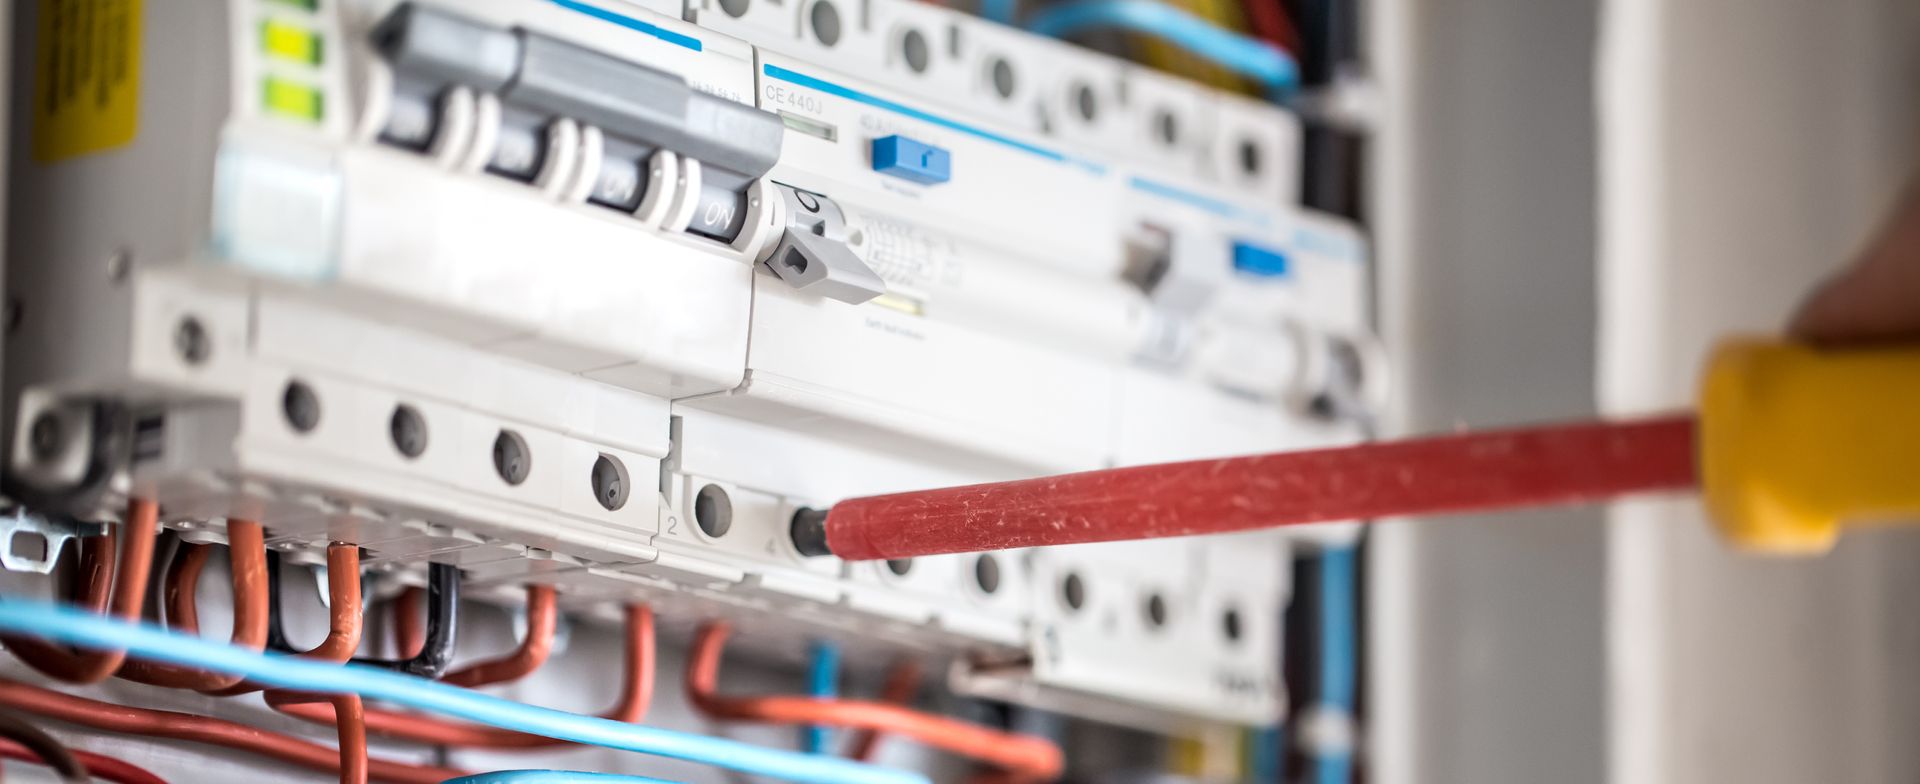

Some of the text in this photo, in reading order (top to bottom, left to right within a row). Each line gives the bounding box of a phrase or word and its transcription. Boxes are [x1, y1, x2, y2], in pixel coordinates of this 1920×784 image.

[765, 84, 784, 104] CE
[787, 91, 823, 115] 440J
[704, 202, 735, 230] ON
[666, 515, 678, 536] 2
